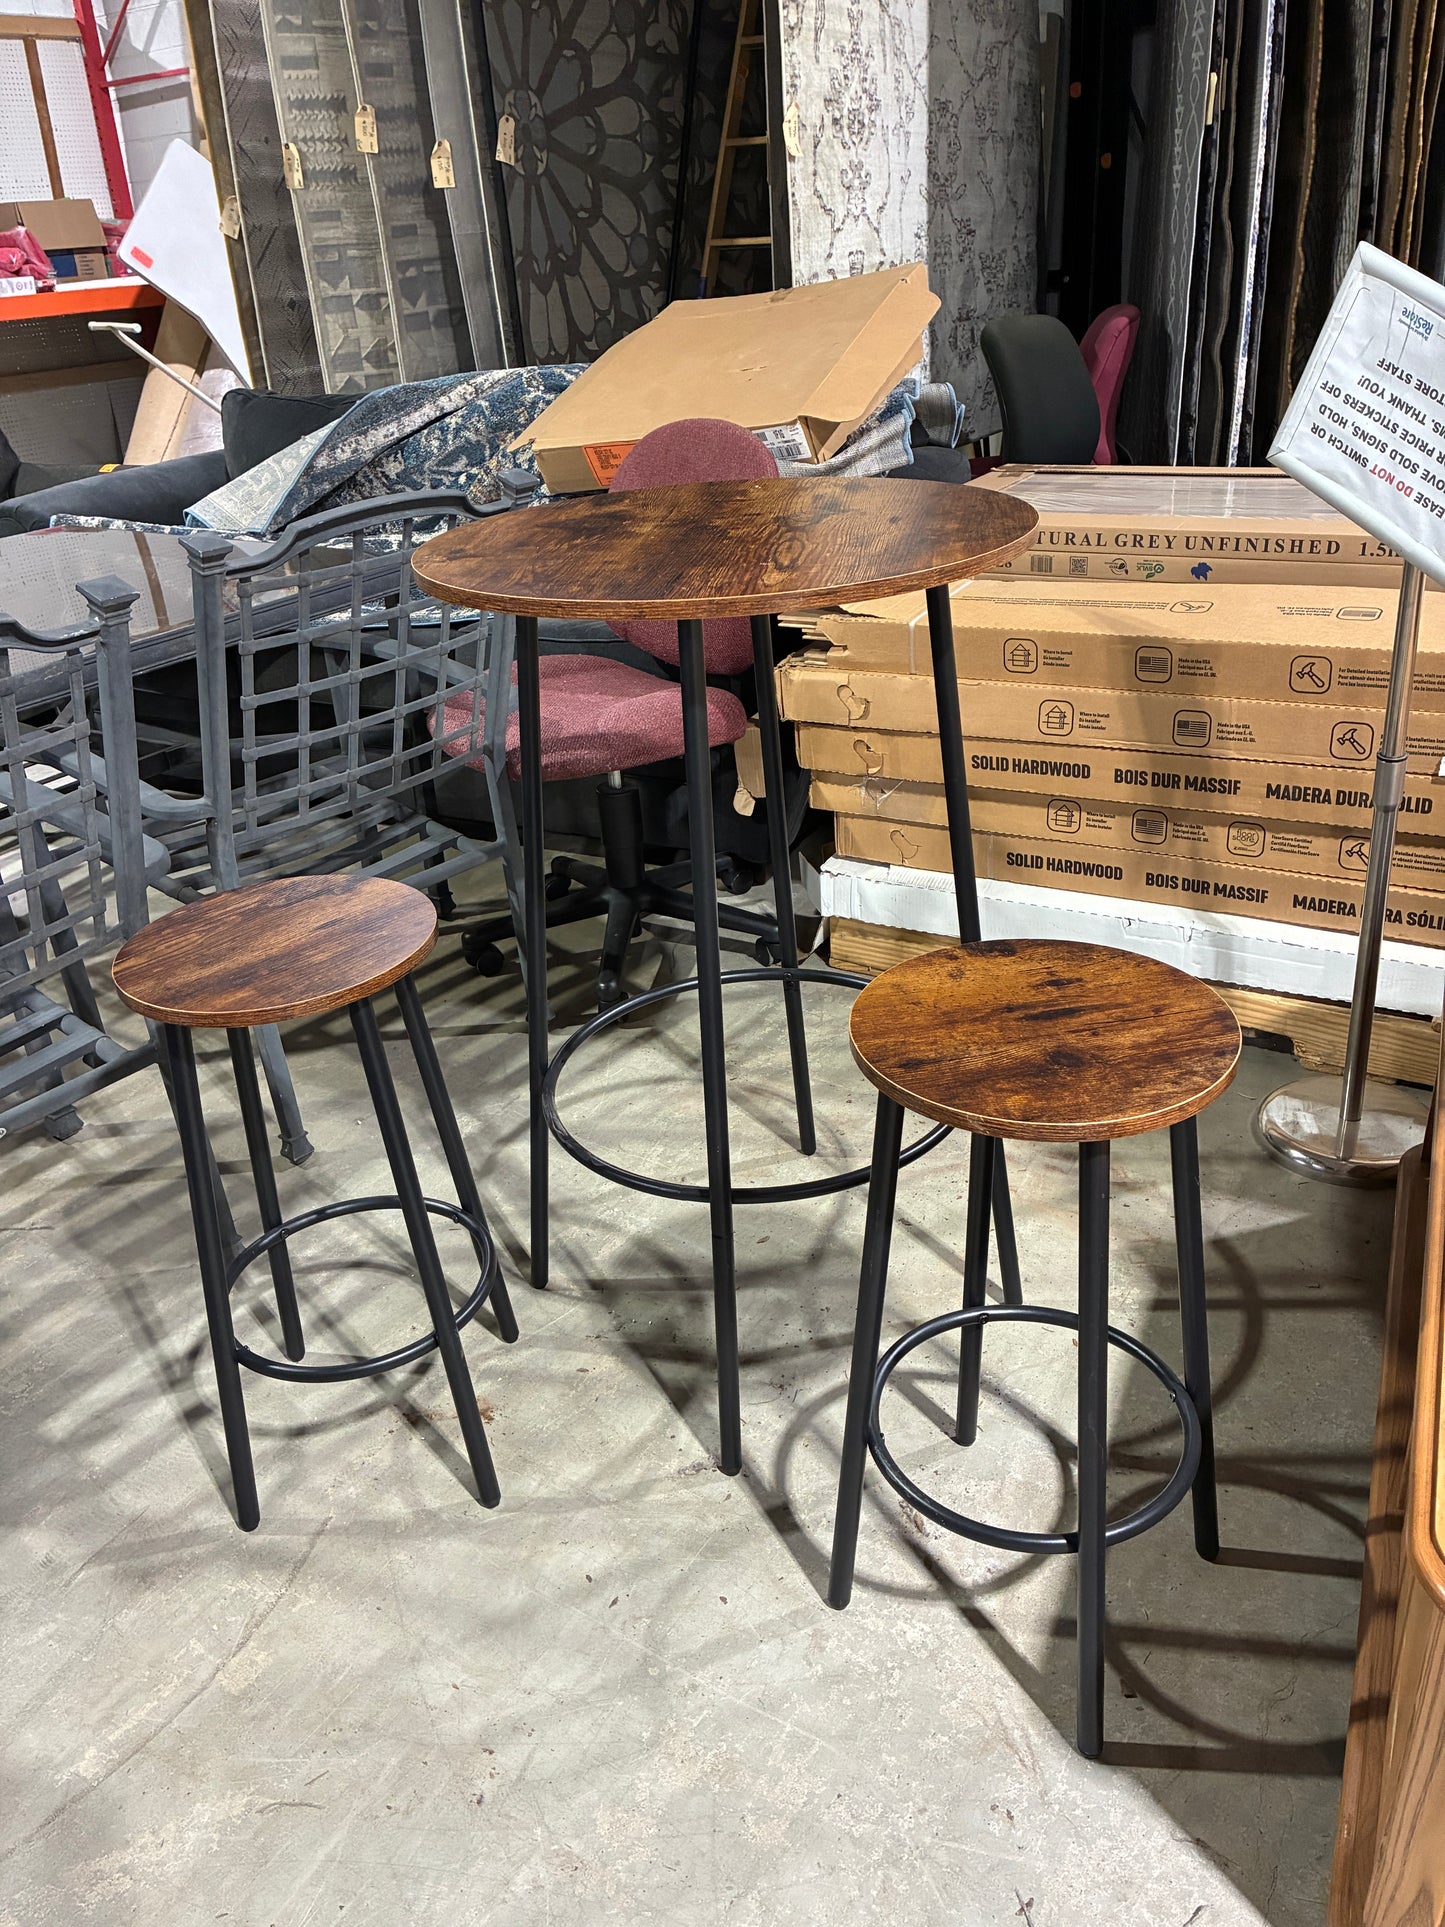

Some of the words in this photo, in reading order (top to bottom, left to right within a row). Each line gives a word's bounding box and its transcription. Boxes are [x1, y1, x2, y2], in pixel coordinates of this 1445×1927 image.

[1402, 307, 1434, 335] ReStore
[1376, 358, 1413, 384] STAFF
[1320, 380, 1342, 398] OFF
[1357, 375, 1385, 399] YOU!
[1414, 378, 1445, 407] TORE
[1319, 404, 1348, 429] HOLD
[1343, 393, 1399, 434] STICKERS
[1387, 392, 1427, 426] THANK
[1311, 422, 1326, 439] OR
[1351, 421, 1388, 453] SIGNS,
[1399, 428, 1435, 458] PRICE
[1327, 434, 1369, 468] SWITCH
[1389, 448, 1420, 474] SOLD
[1369, 463, 1395, 485] NOT
[1420, 468, 1445, 493] OVE
[1396, 480, 1414, 498] DO
[1414, 491, 1445, 519] EASE
[1036, 531, 1108, 547] TURAL
[1114, 533, 1176, 549] GREY
[1184, 535, 1341, 555] UNFINISHED
[971, 755, 1009, 772] SOLID
[1012, 758, 1091, 779] HARDWOOD
[1114, 768, 1148, 786] BOIS
[1151, 772, 1181, 790] DUR
[1184, 776, 1241, 796] MASSIF
[1266, 783, 1332, 805] MADERA
[1006, 852, 1043, 869] SOLID
[1046, 856, 1123, 880] HARDWOOD
[1145, 871, 1178, 890] BOIS
[1181, 876, 1211, 896] DUR
[1213, 883, 1269, 904] MASSIF
[1292, 894, 1357, 918] MADERA
[1360, 904, 1403, 925] RA
